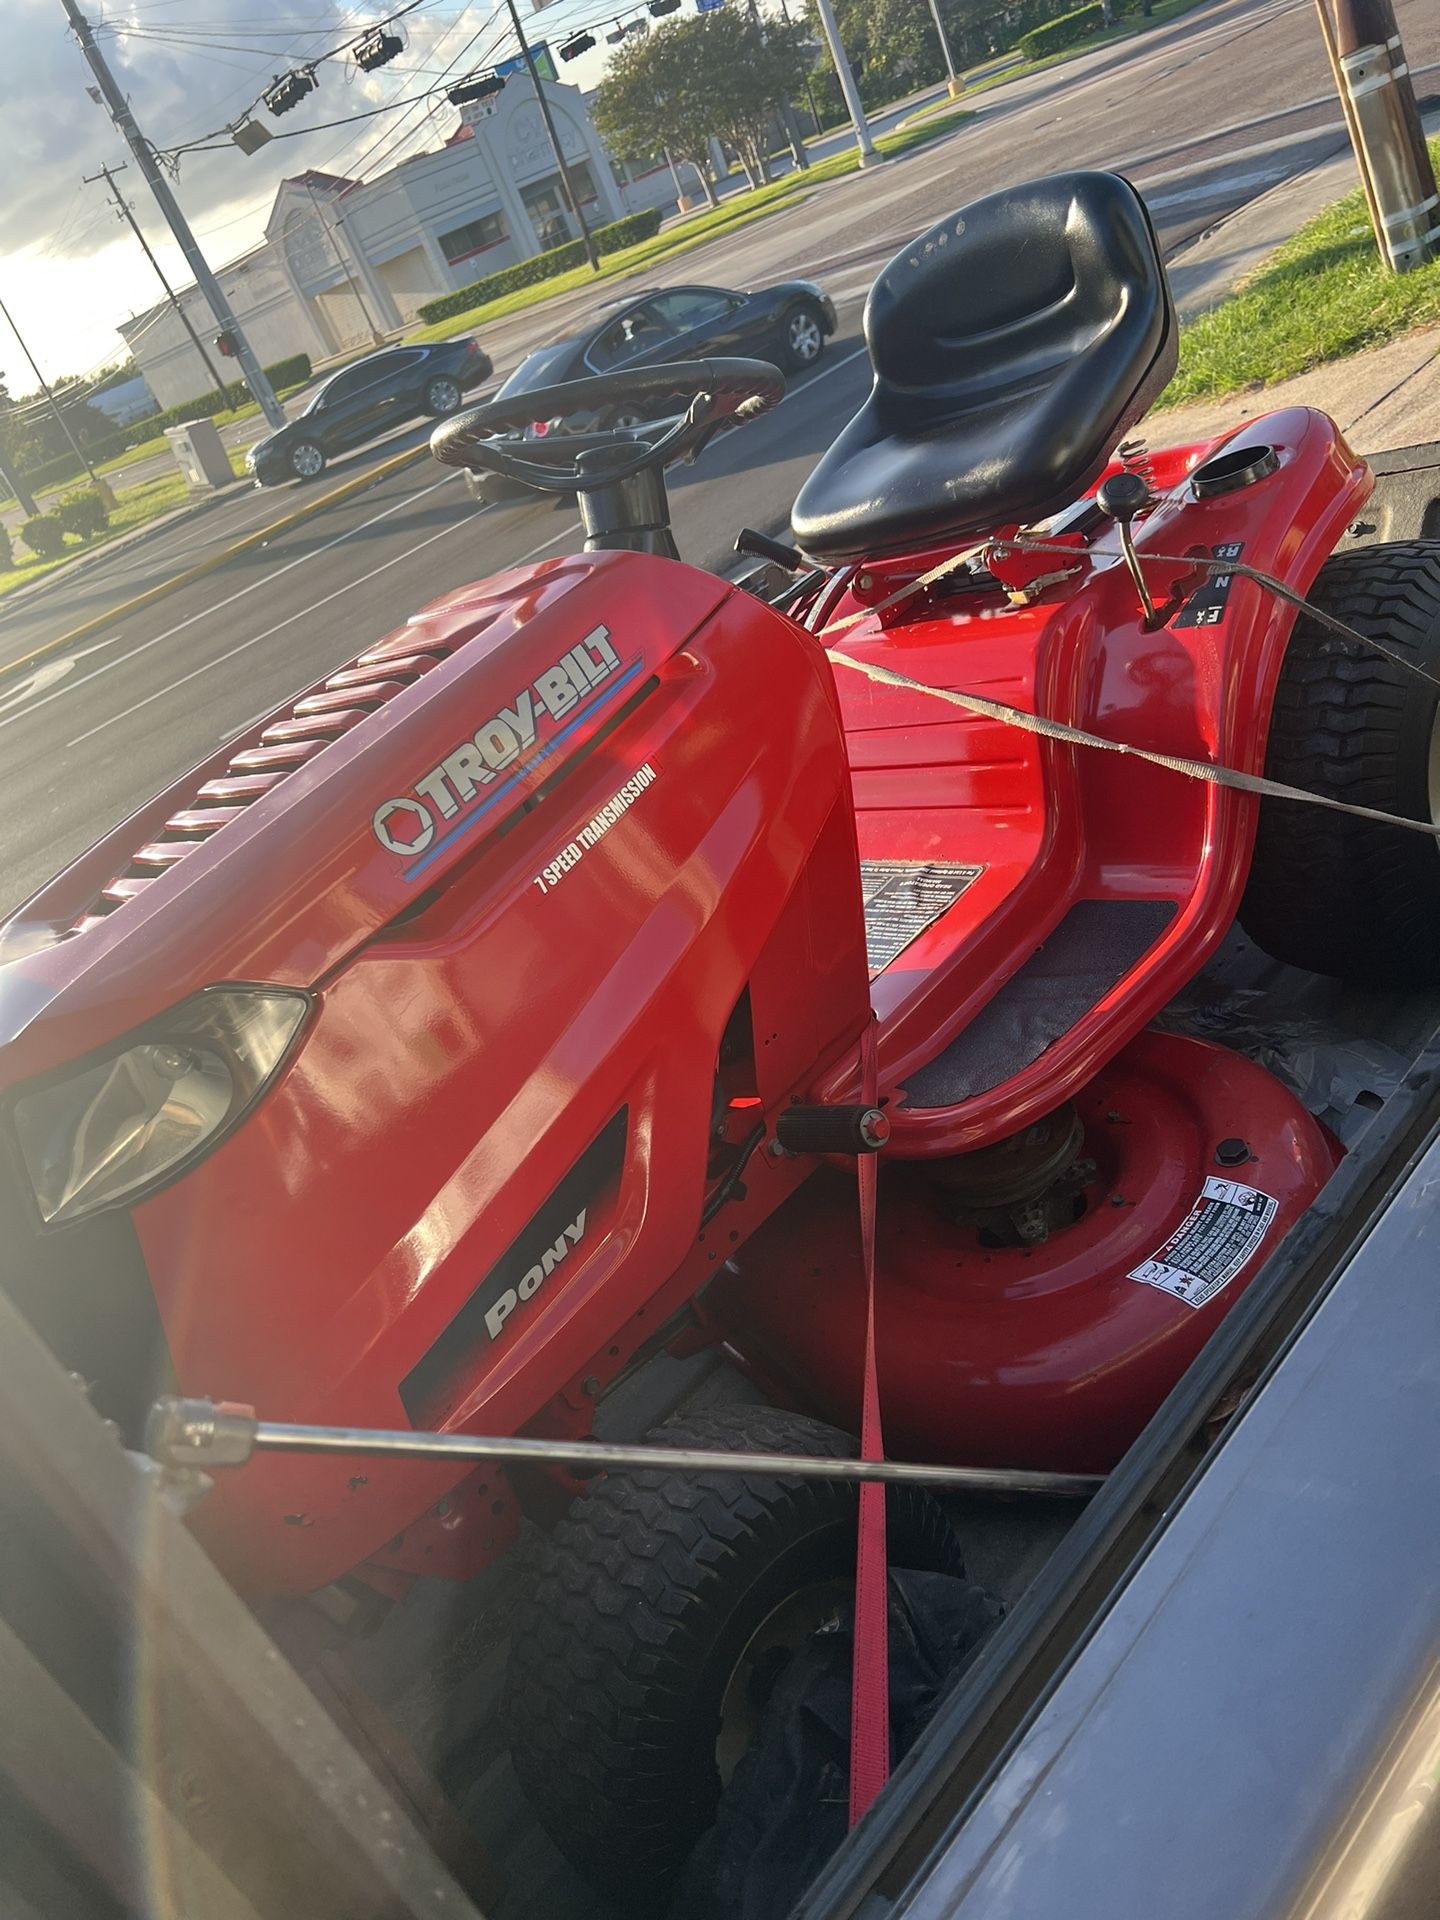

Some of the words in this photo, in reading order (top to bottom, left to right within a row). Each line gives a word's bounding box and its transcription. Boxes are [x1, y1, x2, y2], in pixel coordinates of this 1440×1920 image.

[1215, 576, 1229, 588] N
[413, 623, 622, 820] TROY-BILT
[533, 876, 548, 895] 7
[542, 842, 583, 886] SPEED
[576, 762, 657, 851] TRANSMISSION
[483, 1207, 587, 1341] PONY
[1171, 1209, 1202, 1247] DANGER
